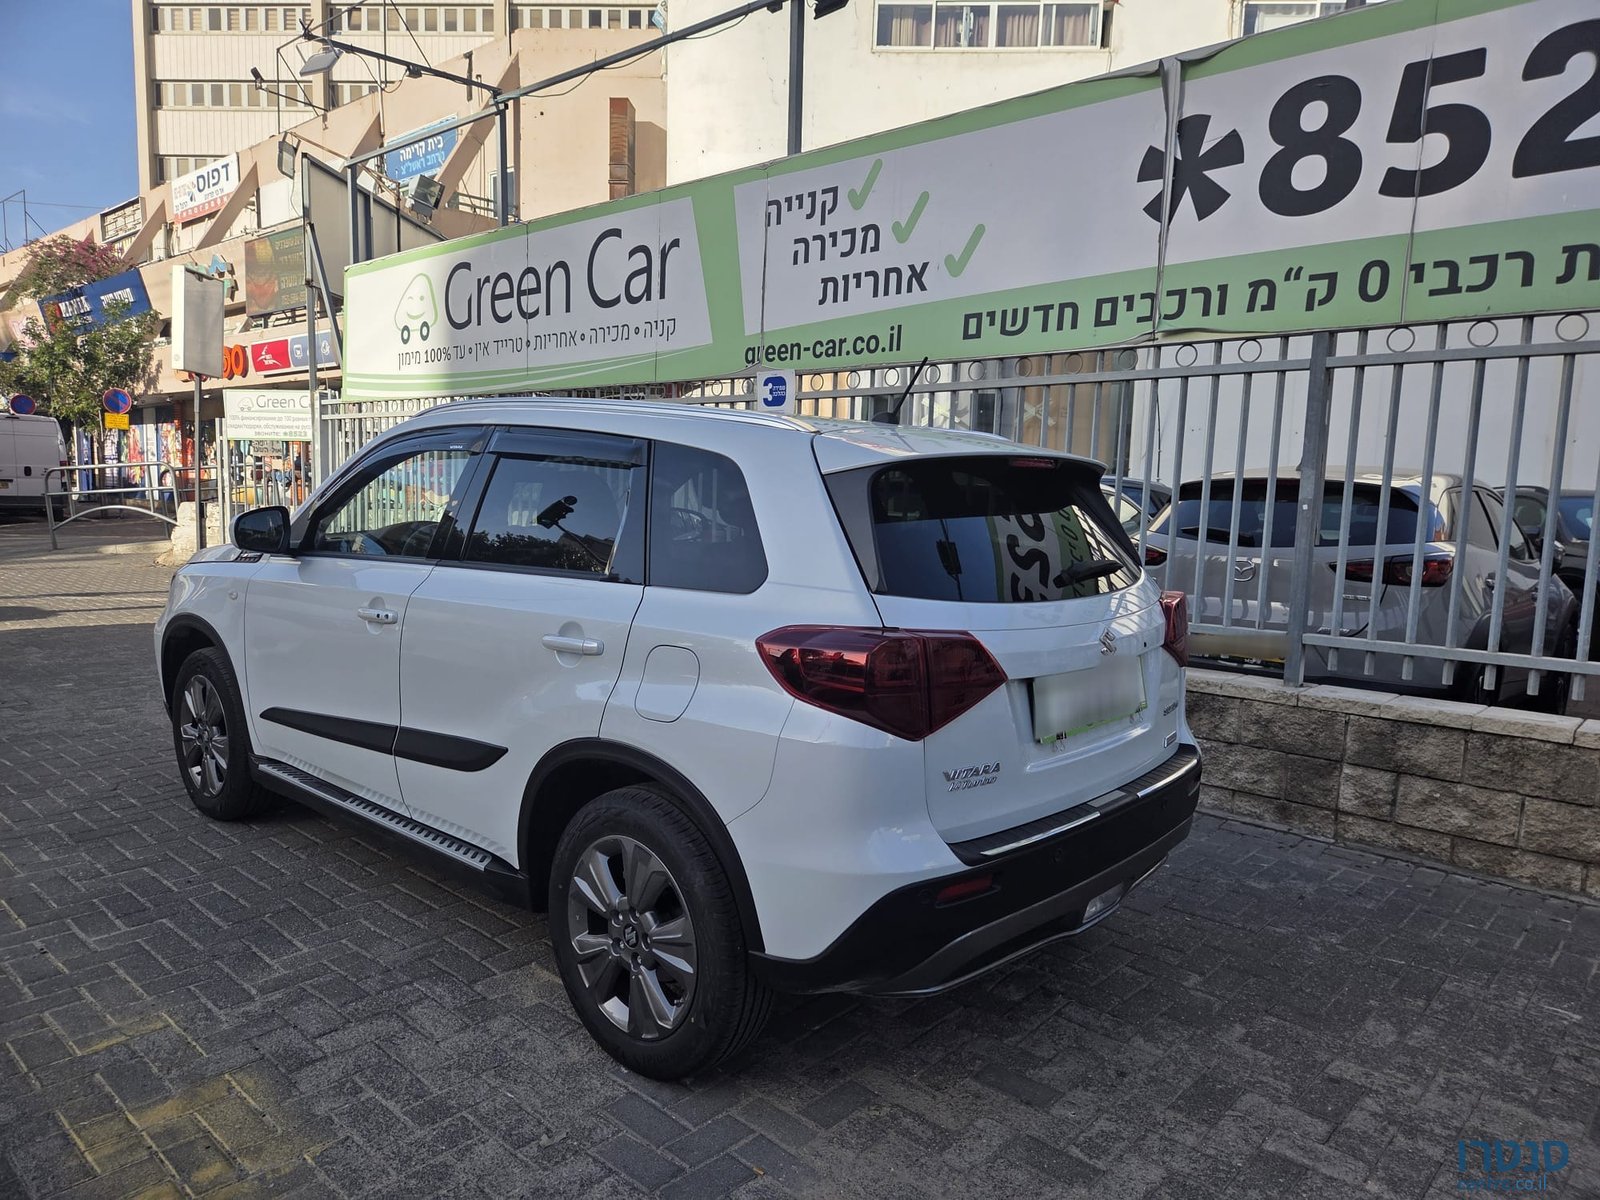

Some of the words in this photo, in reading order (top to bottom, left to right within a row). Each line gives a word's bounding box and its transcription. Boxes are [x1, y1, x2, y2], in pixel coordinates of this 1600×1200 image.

[196, 163, 230, 193] דפוס
[766, 185, 839, 227] קנייה
[792, 223, 881, 266] מכירה
[444, 260, 572, 330] Green
[586, 227, 681, 309] Car
[818, 260, 930, 305] אחריות
[1358, 259, 1390, 303] 0
[1409, 250, 1535, 297] רכבי
[1093, 281, 1229, 329] ורכבים
[588, 321, 630, 345] מכירה
[643, 316, 677, 342] קניה
[962, 300, 1080, 340] חדשים
[424, 345, 452, 363] 100%
[452, 344, 466, 361] עד
[474, 340, 490, 362] אין
[493, 336, 523, 355] טרייד
[533, 328, 577, 352] אחריות
[744, 324, 902, 367] green-car.co.il
[397, 349, 422, 371] מימון
[256, 394, 296, 409] Green
[943, 761, 1001, 781] VITARA
